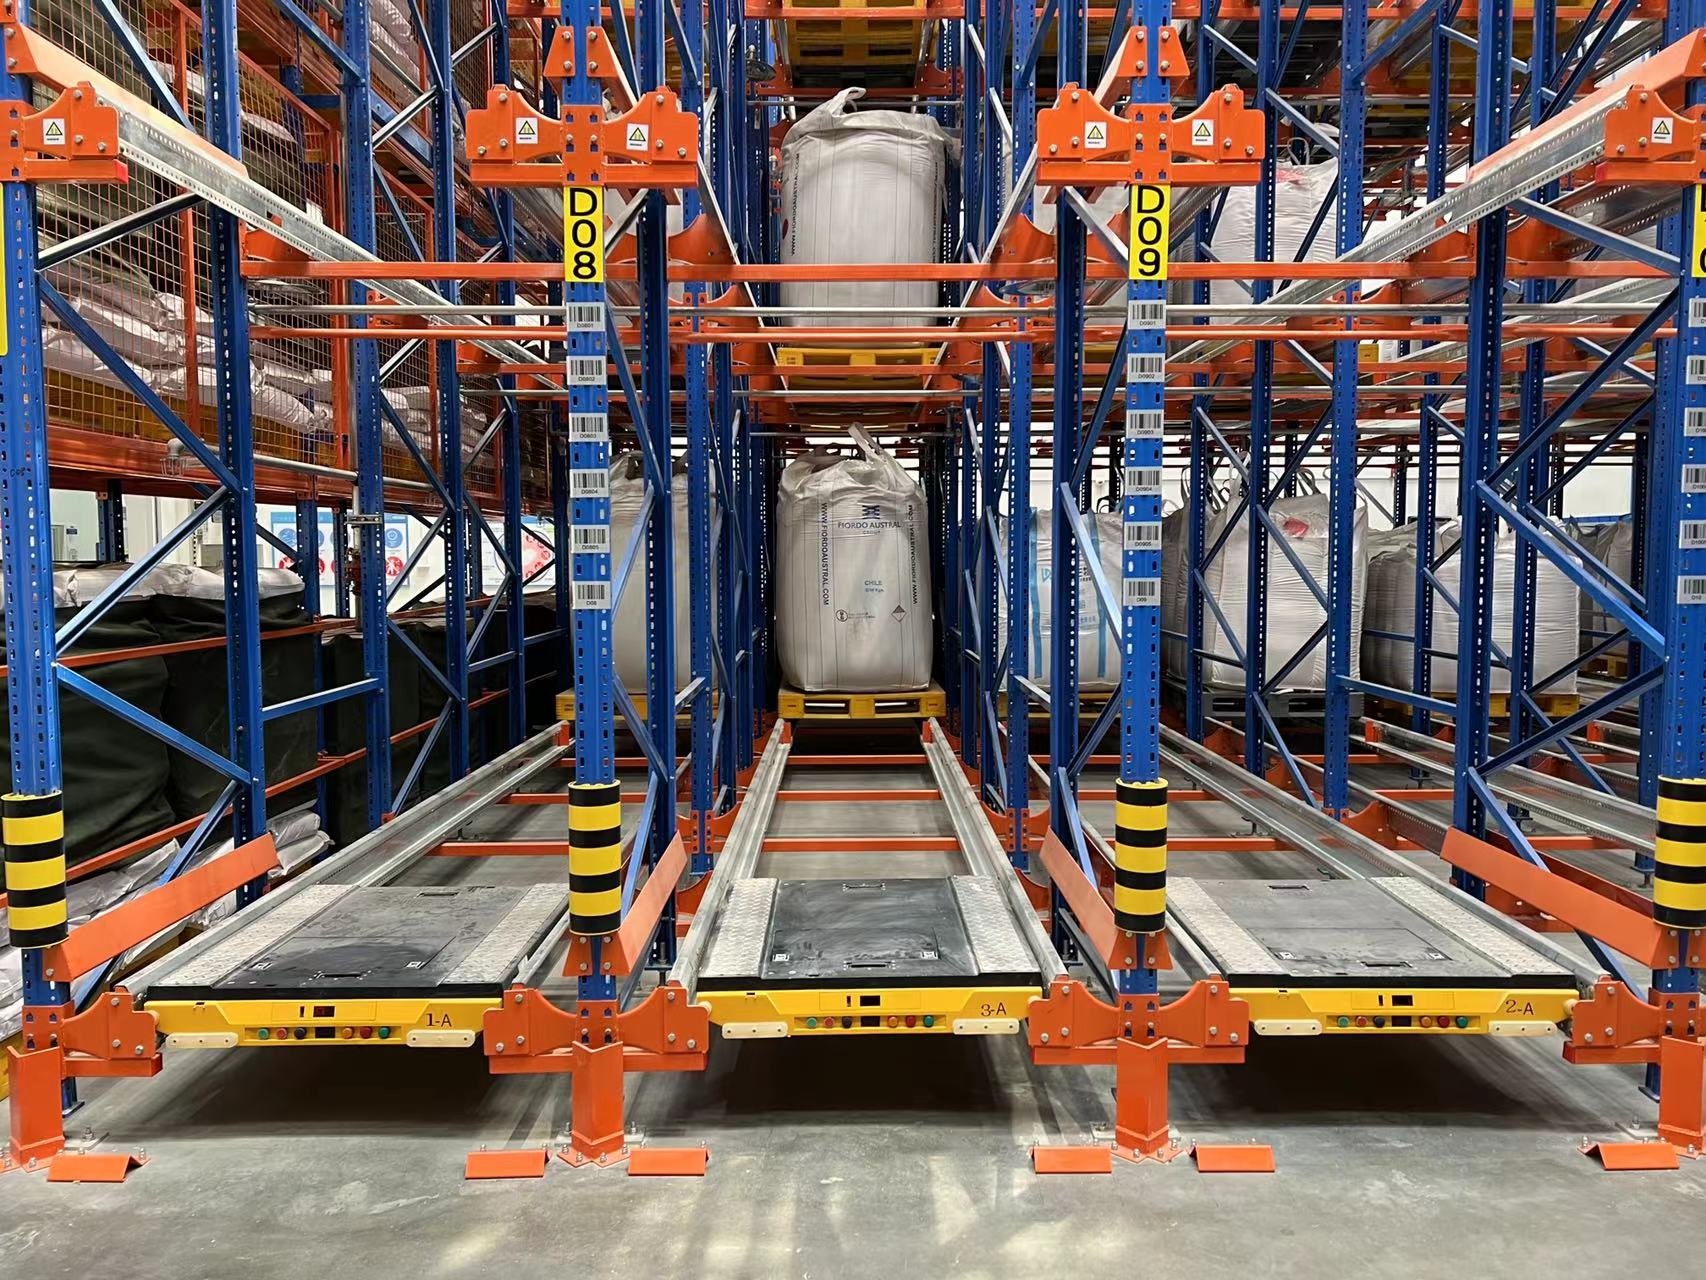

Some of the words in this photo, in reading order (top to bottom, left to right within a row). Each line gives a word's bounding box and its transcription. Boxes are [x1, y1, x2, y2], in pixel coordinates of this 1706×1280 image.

[569, 187, 598, 280] D08
[1137, 184, 1165, 277] D09
[980, 1001, 1007, 1017] 3-A
[1505, 999, 1534, 1016] 2-A
[425, 1012, 452, 1027] 1-A
